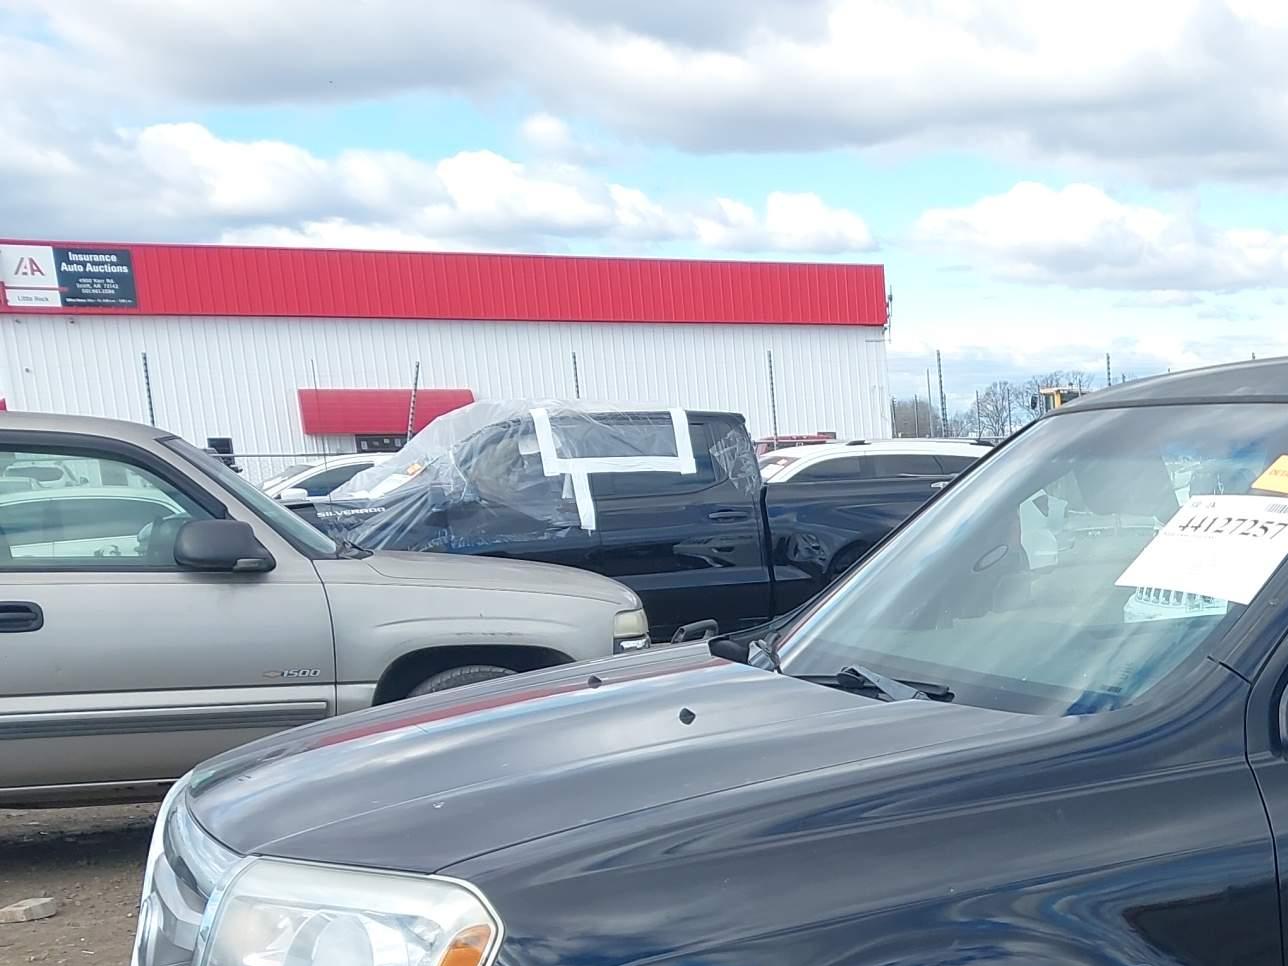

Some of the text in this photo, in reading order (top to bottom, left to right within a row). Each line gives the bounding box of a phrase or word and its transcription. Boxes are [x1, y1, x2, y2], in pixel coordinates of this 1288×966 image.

[68, 252, 117, 262] Insurance
[61, 262, 128, 273] Auto Auctions
[317, 507, 385, 518] SILVERADO
[1179, 514, 1288, 540] 44127257
[282, 668, 321, 678] 1500
